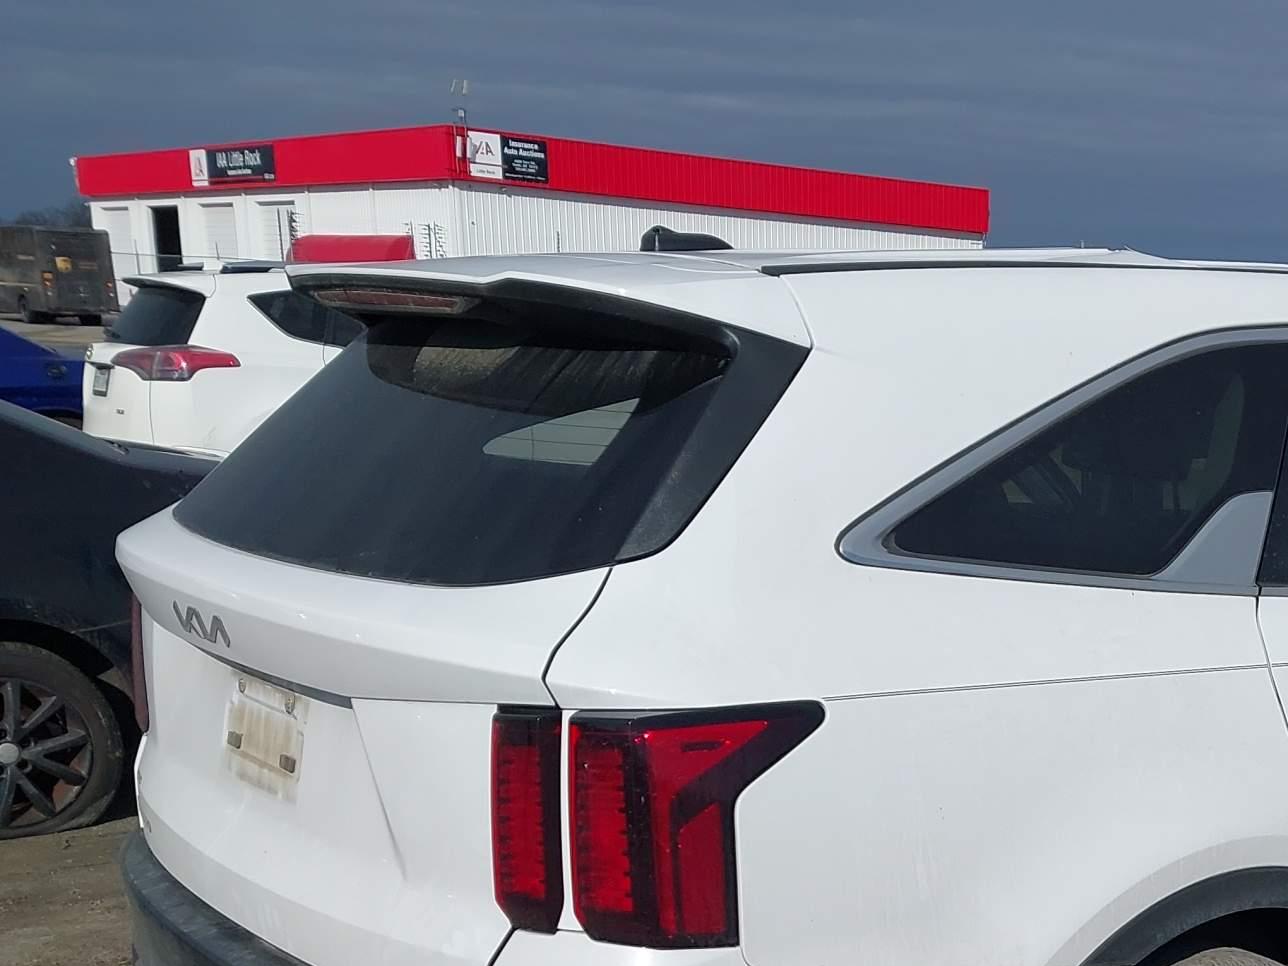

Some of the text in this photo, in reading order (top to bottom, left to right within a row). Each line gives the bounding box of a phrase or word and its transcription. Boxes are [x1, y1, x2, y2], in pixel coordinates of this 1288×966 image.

[509, 139, 539, 150] Insurance
[215, 152, 228, 168] IAA
[228, 151, 244, 167] Little
[244, 149, 262, 166] Rock
[503, 146, 545, 159] Auto Auctions
